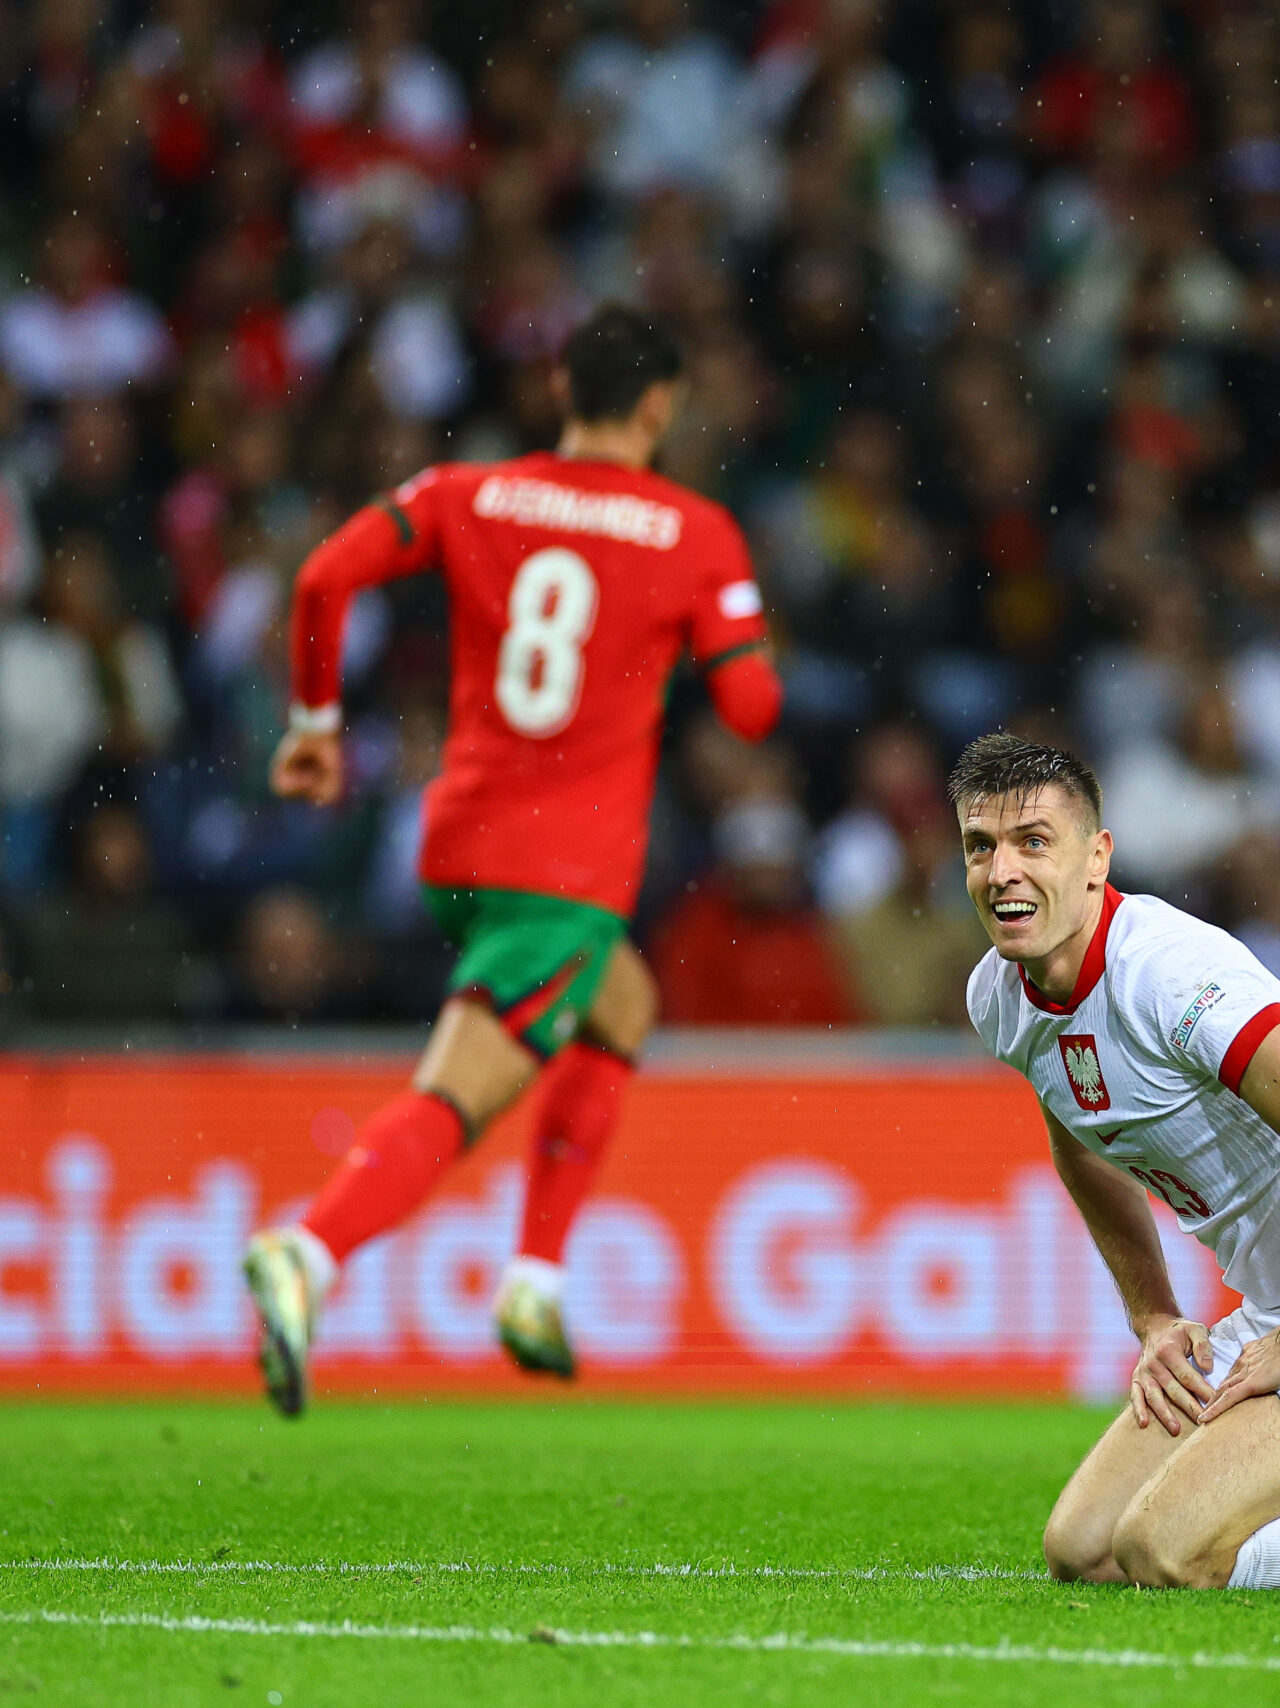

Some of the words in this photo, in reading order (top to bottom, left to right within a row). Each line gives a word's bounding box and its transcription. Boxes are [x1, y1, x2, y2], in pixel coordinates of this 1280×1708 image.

[496, 547, 600, 739] 8
[1175, 984, 1221, 1048] FOUNDATION
[1128, 1166, 1214, 1219] 23
